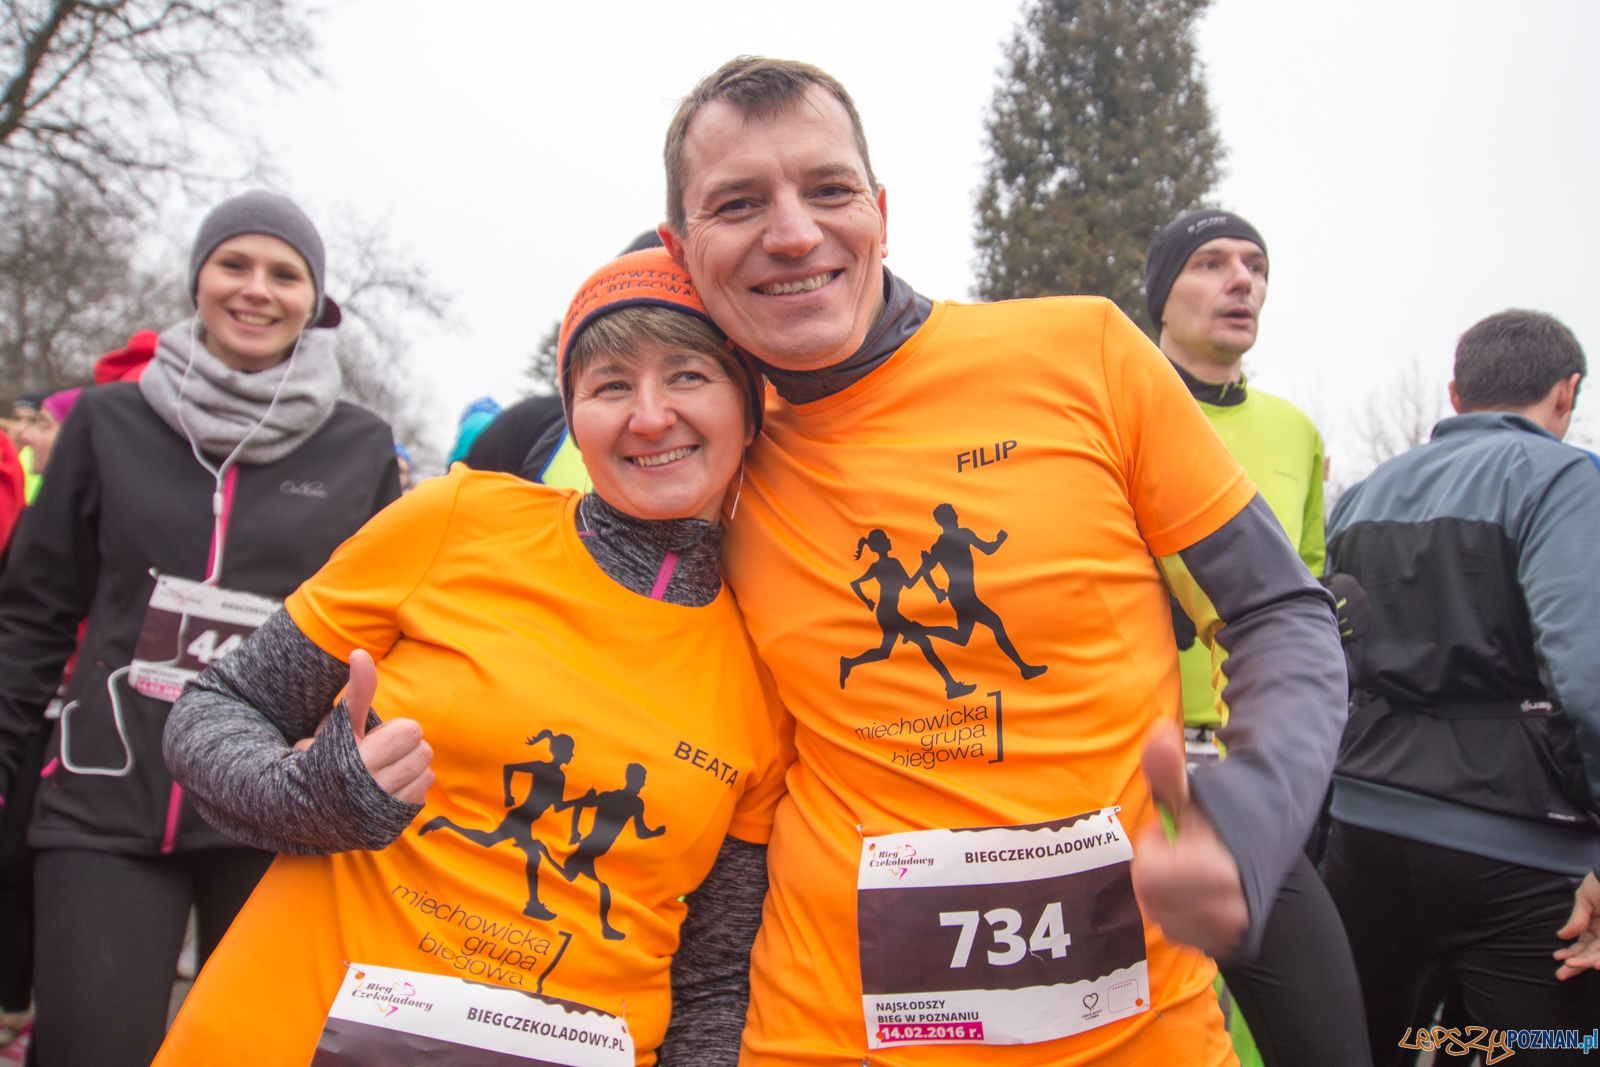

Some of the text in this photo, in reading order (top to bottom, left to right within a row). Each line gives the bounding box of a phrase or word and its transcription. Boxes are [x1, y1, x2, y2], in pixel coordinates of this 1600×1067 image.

[956, 439, 1018, 473] FILIP
[854, 705, 988, 740] miechowicka
[920, 723, 986, 751] grupa
[673, 740, 739, 789] BEATA
[869, 856, 935, 868] Czekoladowy
[878, 850, 899, 860] Bieg
[964, 831, 1119, 864] BIEGCZEKOLADOWY.PL
[390, 884, 551, 955] miechowicka
[939, 902, 1071, 968] 734
[417, 931, 524, 986] biegowa
[462, 935, 537, 971] grupa
[351, 989, 434, 1012] Czekoladowy
[366, 983, 393, 994] Bieg
[875, 999, 946, 1013] NAJSŁODSZY
[877, 1011, 979, 1024] BIEG W POZNANIU
[466, 1007, 626, 1052] BIEGCZEKOLADOWY.PL
[881, 1026, 982, 1040] 14.02.2016 r.
